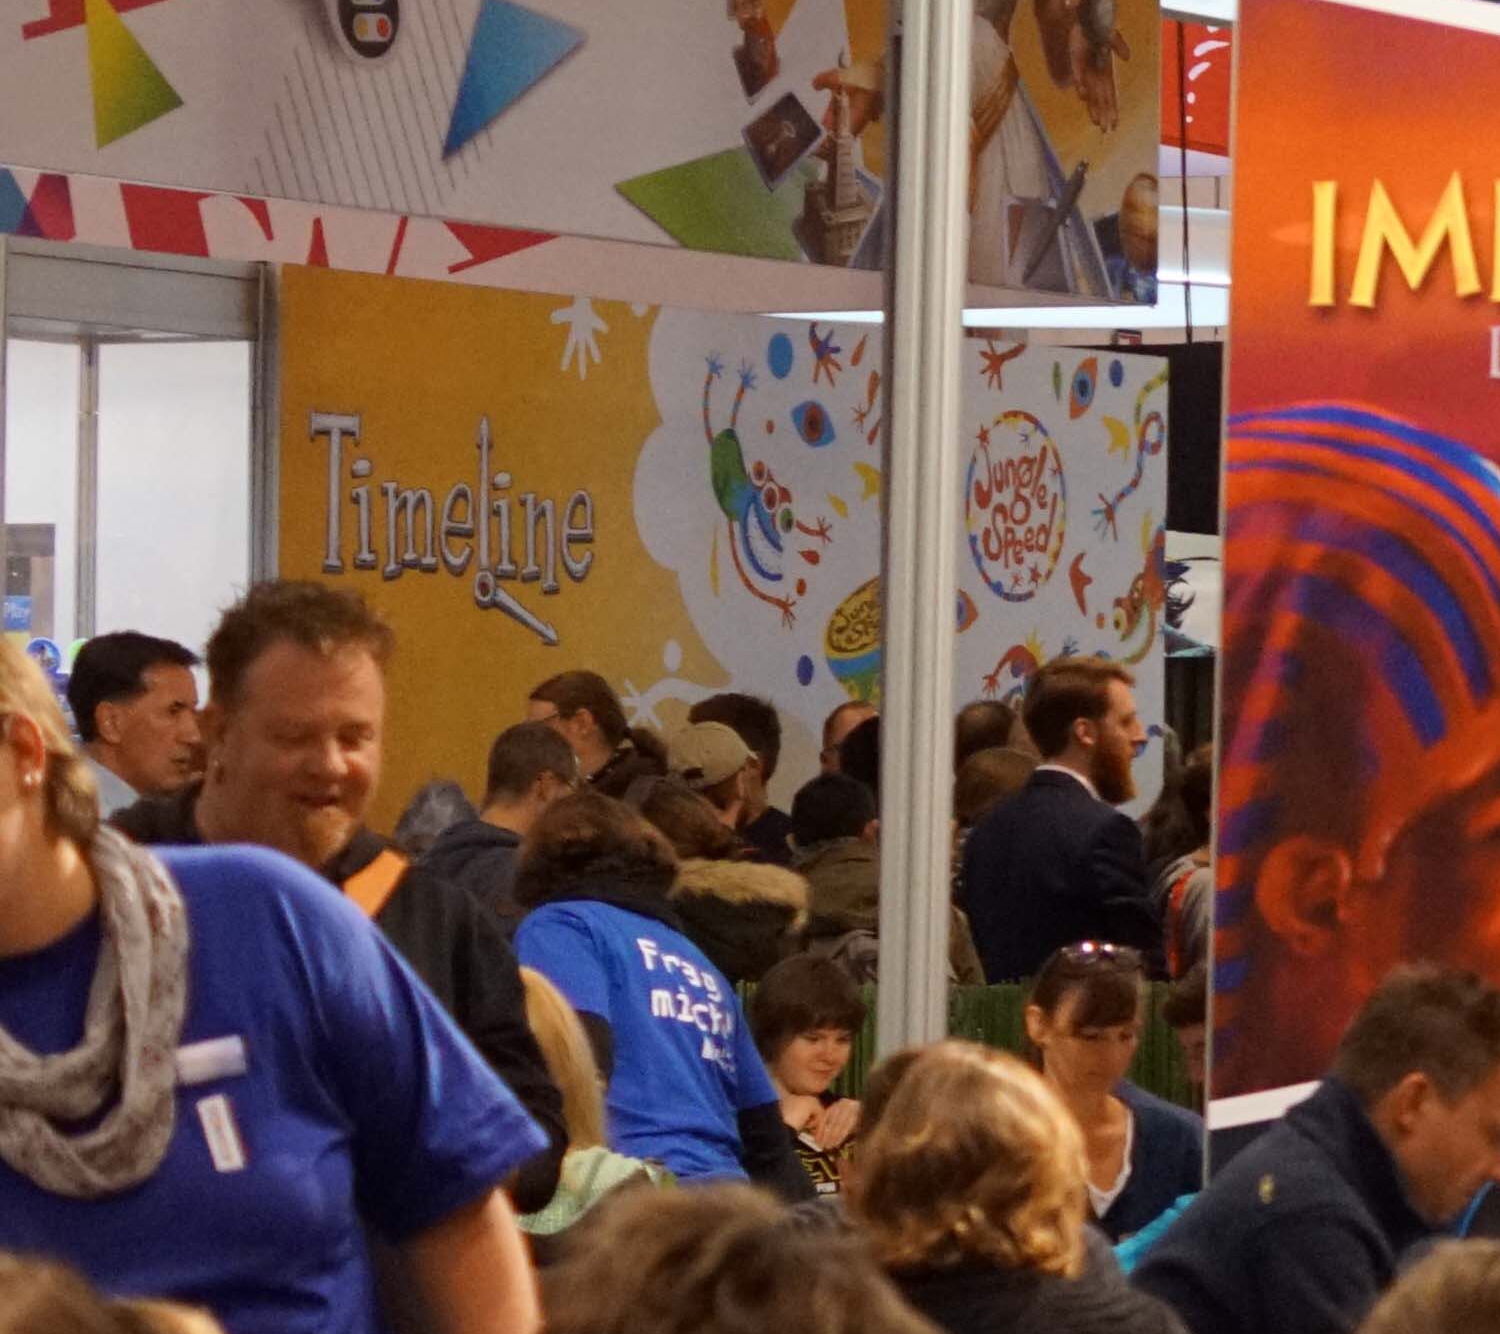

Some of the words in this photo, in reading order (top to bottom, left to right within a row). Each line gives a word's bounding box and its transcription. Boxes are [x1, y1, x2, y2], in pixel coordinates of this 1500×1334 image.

[309, 412, 595, 609] Timeline
[974, 444, 1049, 525] Jungle
[981, 492, 1059, 570] Speed
[636, 937, 722, 1003] Frag
